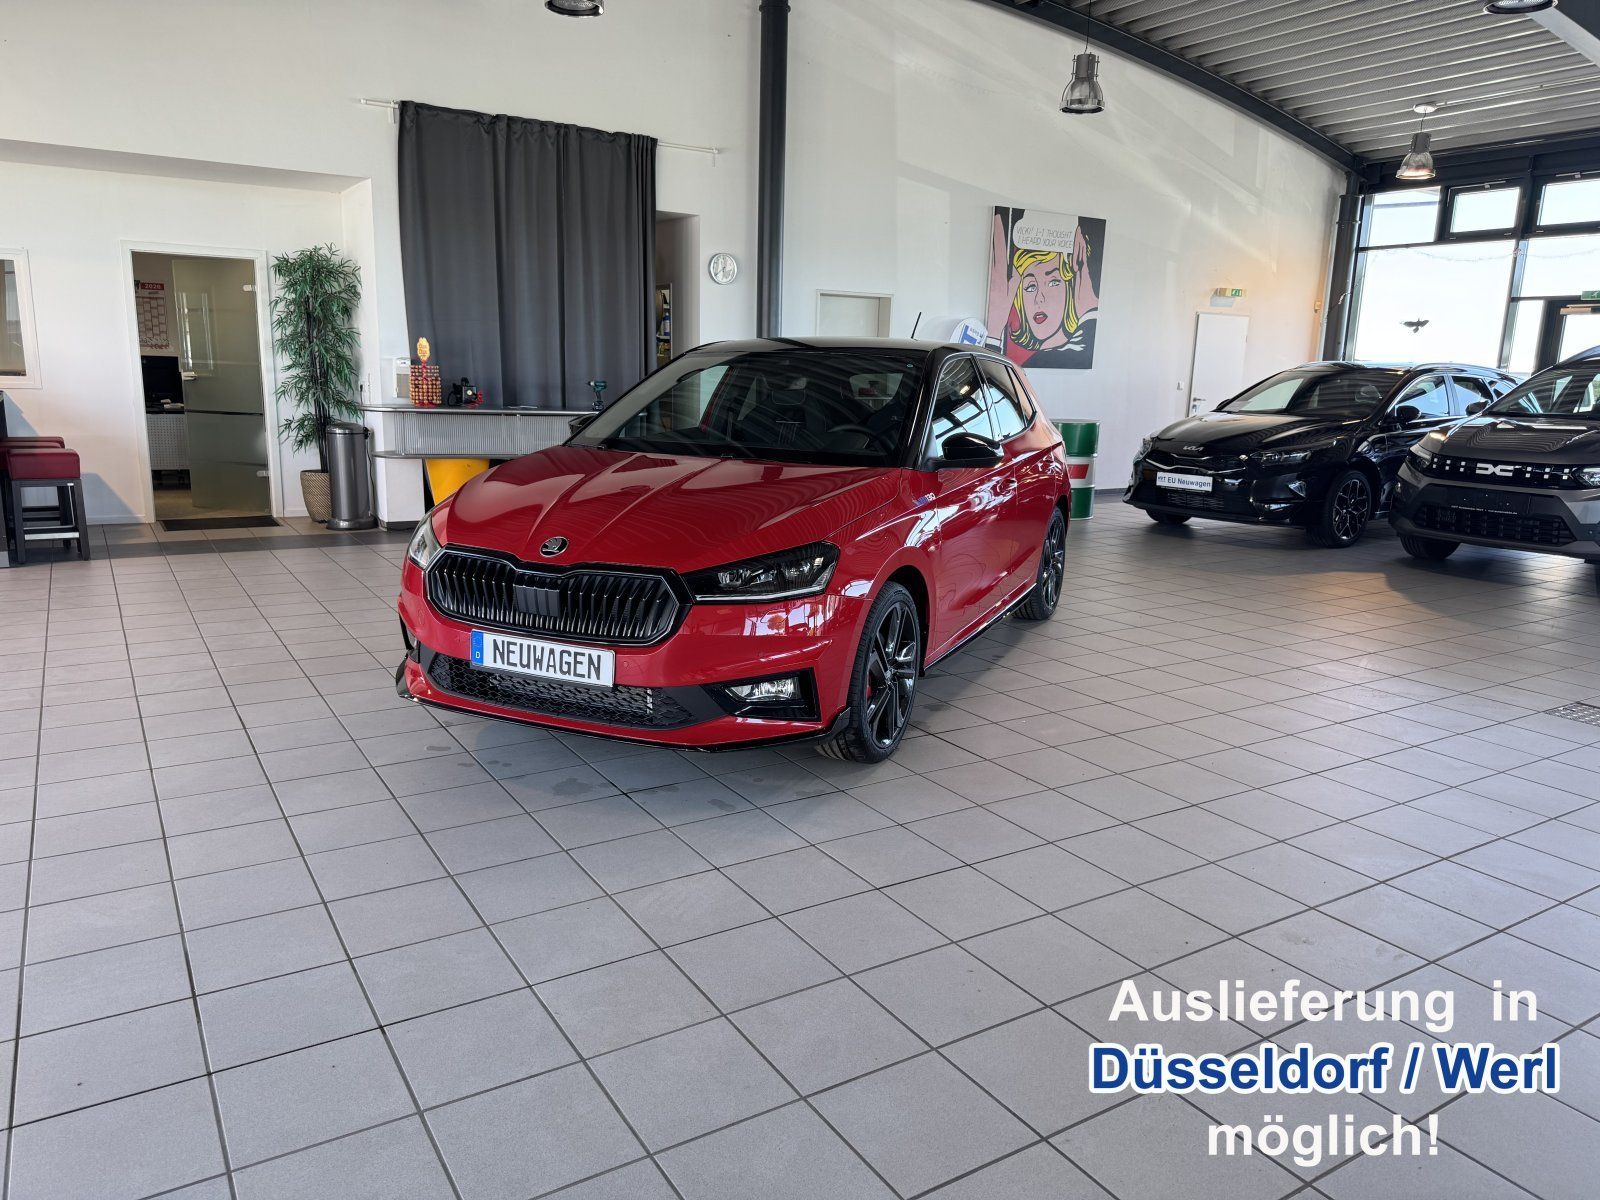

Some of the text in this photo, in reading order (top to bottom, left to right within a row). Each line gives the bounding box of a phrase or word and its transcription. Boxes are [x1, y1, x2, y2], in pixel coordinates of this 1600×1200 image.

[1167, 476, 1176, 484] EU
[1177, 478, 1211, 488] Neuwagen
[475, 651, 481, 659] D
[492, 638, 601, 681] NEUWAGEN
